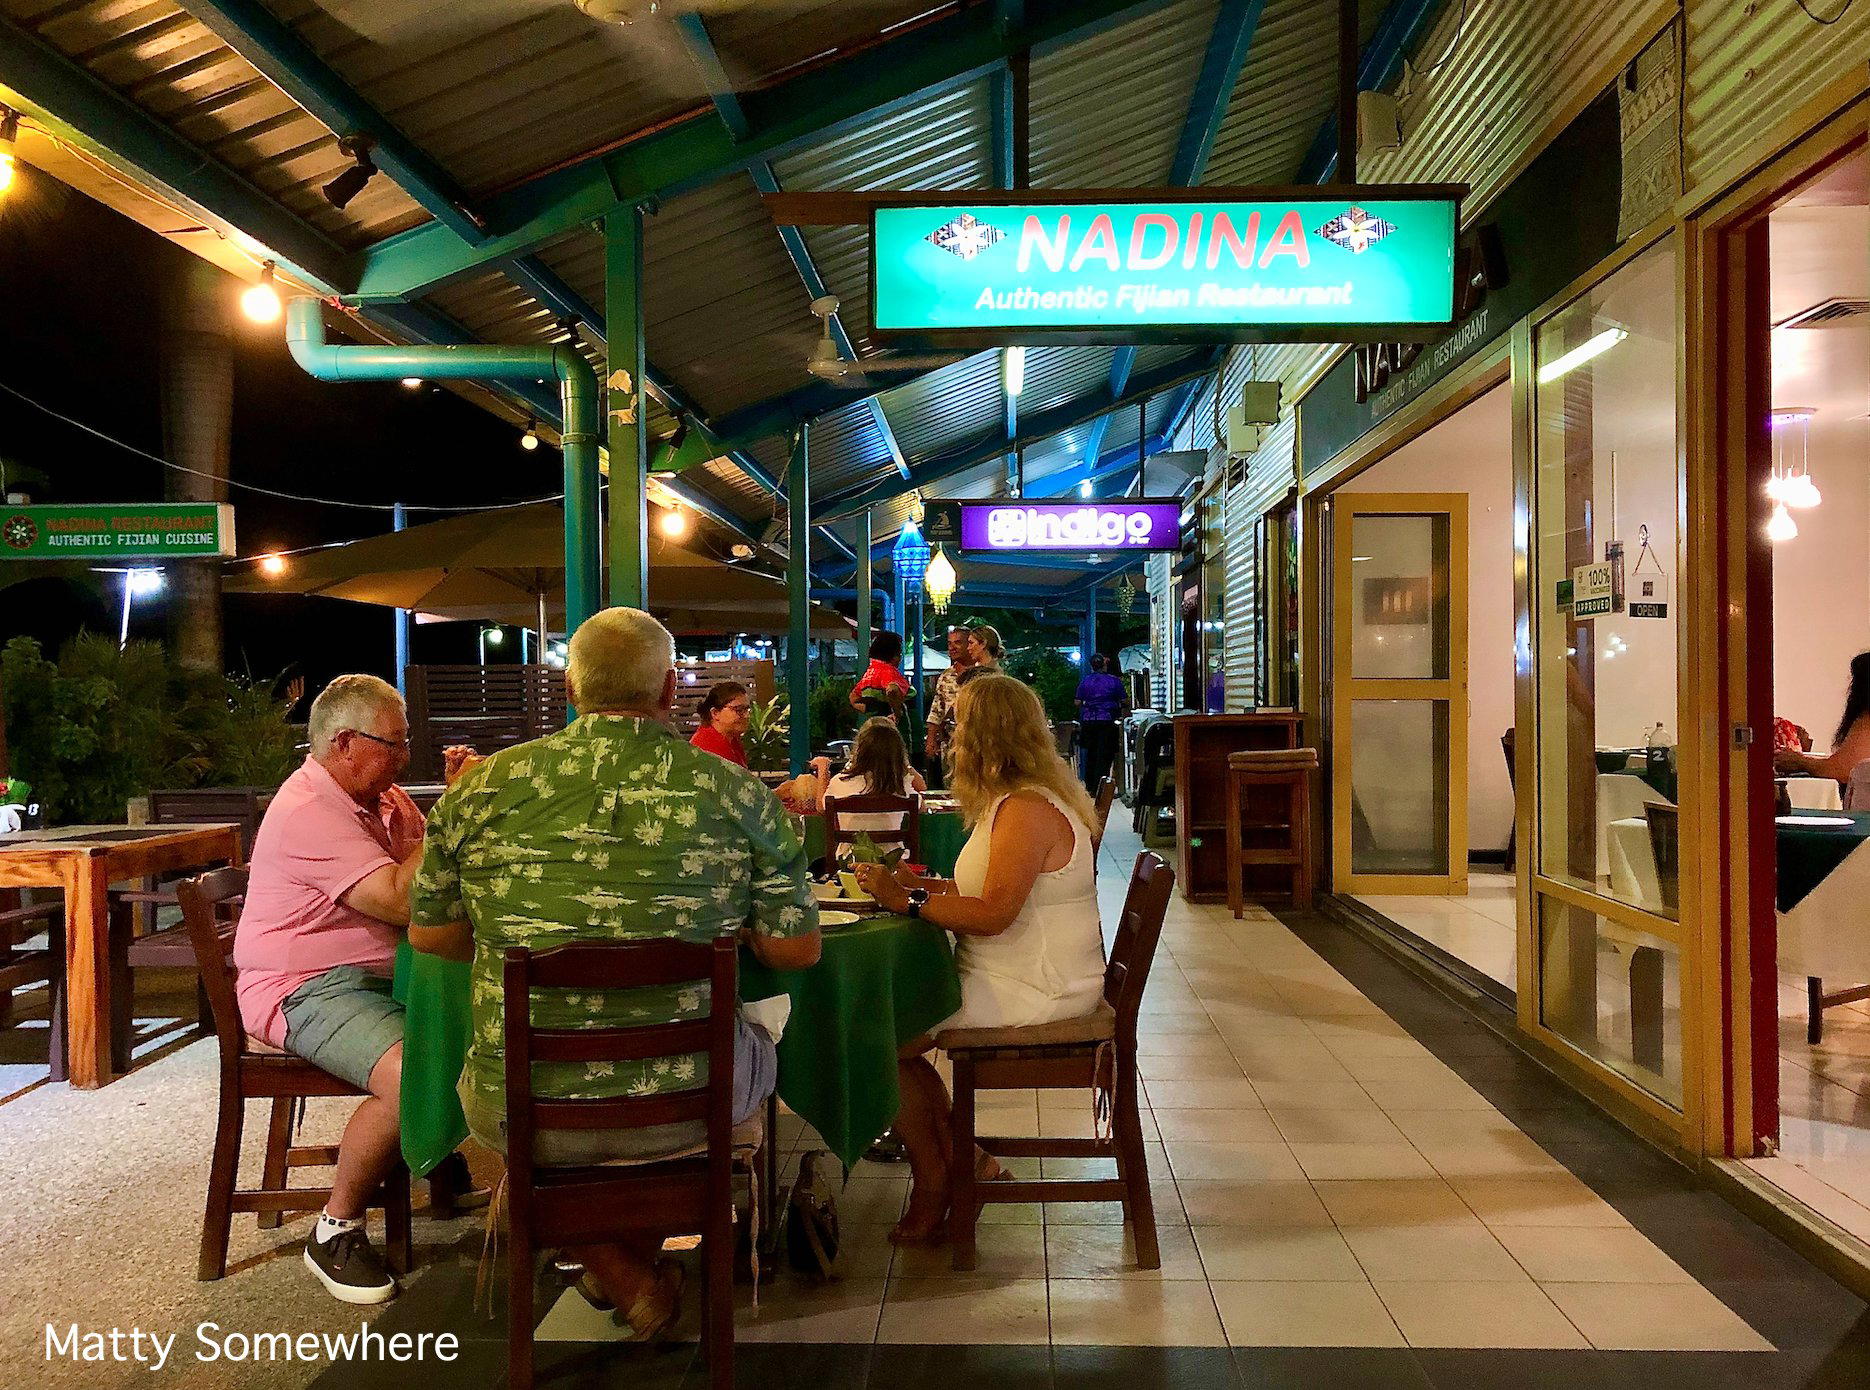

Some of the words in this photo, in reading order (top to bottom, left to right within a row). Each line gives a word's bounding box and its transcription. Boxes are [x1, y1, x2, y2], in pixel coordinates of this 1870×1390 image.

[1016, 210, 1311, 273] NADINA
[975, 286, 1108, 311] Authentic
[1115, 284, 1190, 313] Fijian
[1196, 281, 1353, 308] Restaurant
[1433, 308, 1489, 371] RESTAURANT
[48, 534, 112, 546] AUTHENTIC
[117, 534, 160, 545] FIJIAN
[165, 533, 214, 545] CUISINE
[1588, 567, 1611, 587] 100%
[1576, 598, 1610, 614] APPROVED
[1636, 604, 1659, 617] OPEN
[1652, 750, 1665, 762] 2
